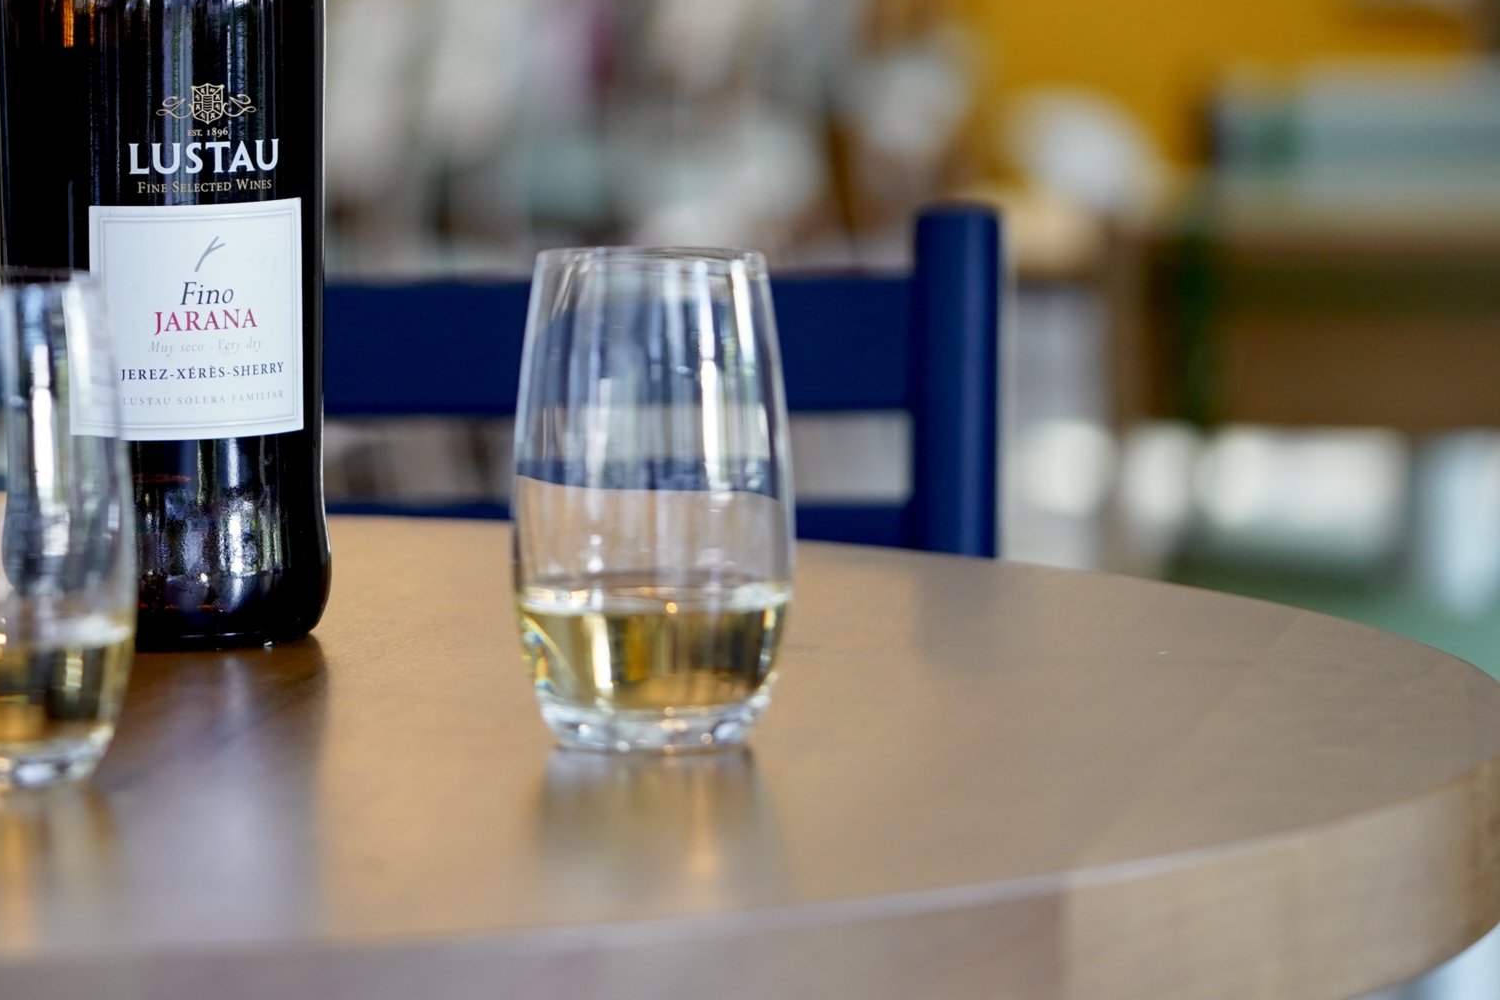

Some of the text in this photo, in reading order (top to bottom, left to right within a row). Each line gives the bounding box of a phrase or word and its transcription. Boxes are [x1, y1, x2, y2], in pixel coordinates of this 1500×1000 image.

[207, 126, 228, 138] 1896
[128, 138, 280, 175] LUSTAU
[180, 281, 235, 306] Fino
[154, 307, 258, 336] JARANA
[121, 361, 284, 382] JEREZ-XÉRÈS-SHERRY
